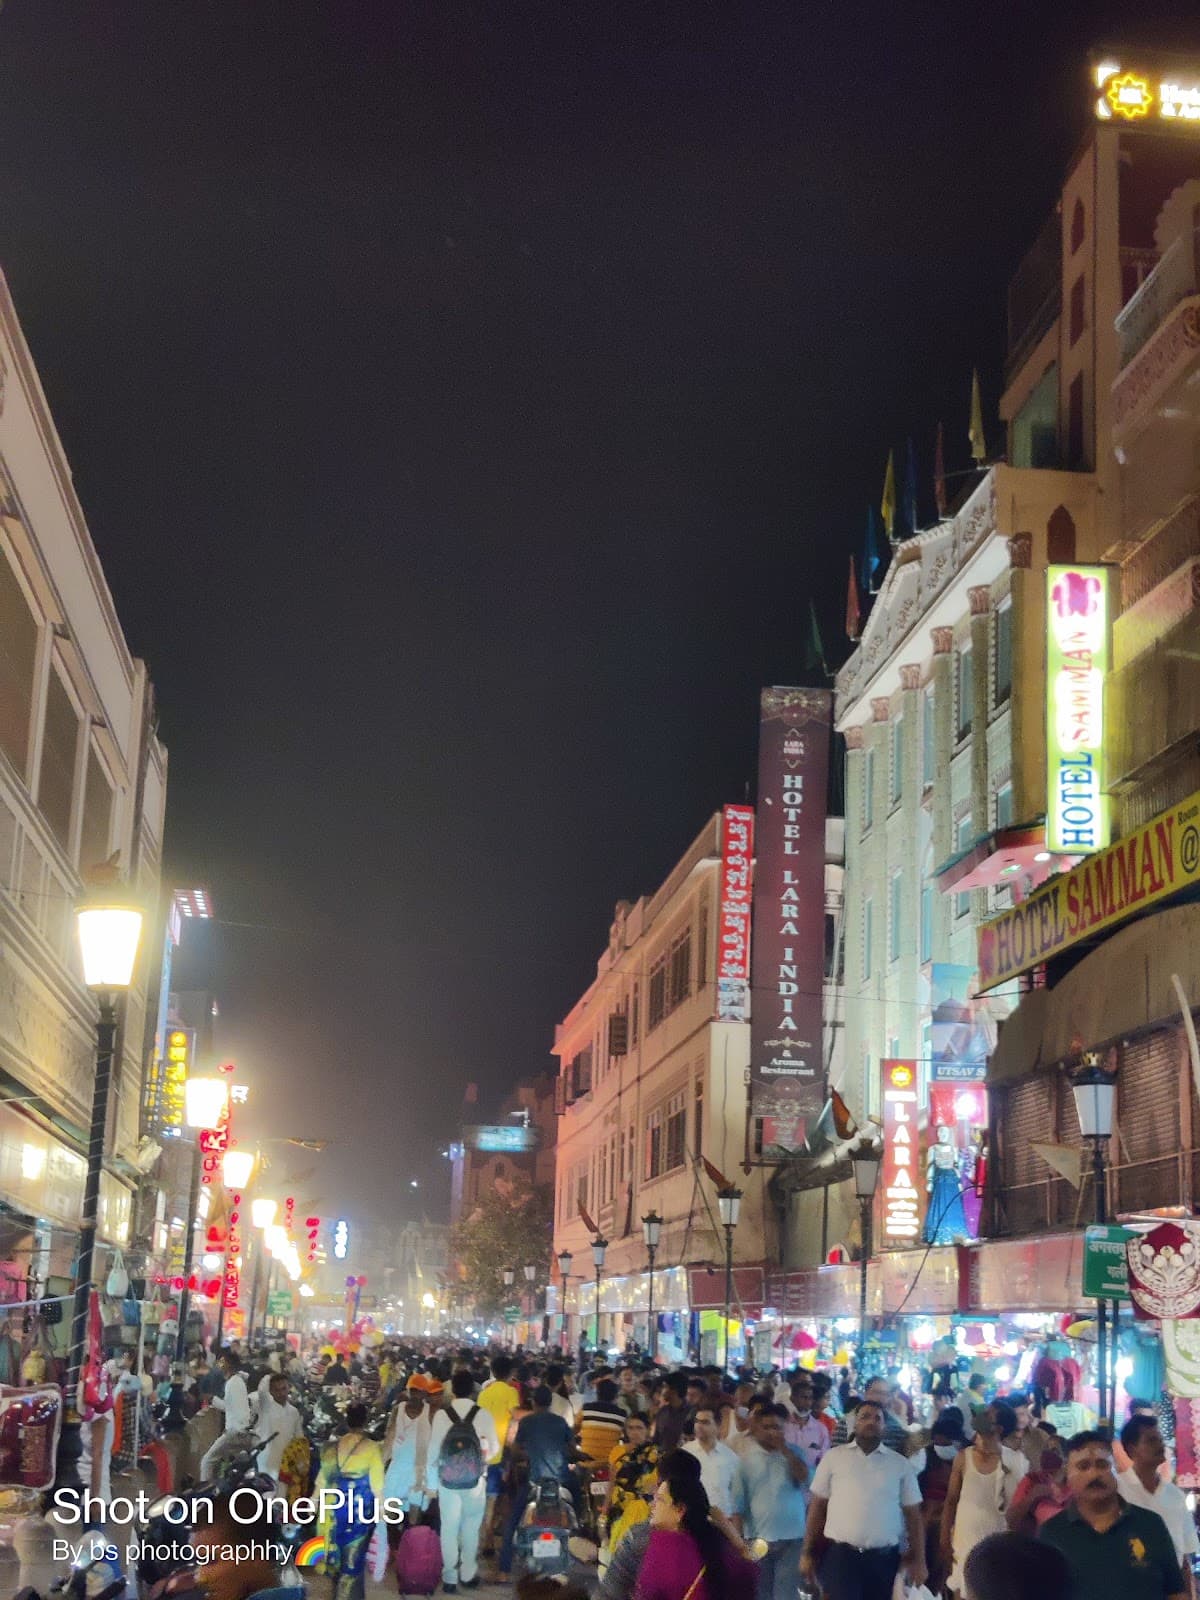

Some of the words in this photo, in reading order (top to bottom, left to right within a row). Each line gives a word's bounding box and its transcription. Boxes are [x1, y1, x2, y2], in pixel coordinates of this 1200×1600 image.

[1061, 630, 1093, 744] SAMMAN
[783, 775, 803, 855] HOTEL
[1060, 752, 1094, 847] HOTEL
[779, 870, 800, 935] LARA
[995, 885, 1065, 974] HOTEL
[1067, 816, 1174, 937] SAMMAN
[777, 948, 799, 1030] INDIA
[760, 1066, 815, 1076] Restaurant
[770, 1058, 805, 1067] Aroma
[937, 1066, 974, 1076] UTSAV
[892, 1102, 911, 1188] LARA
